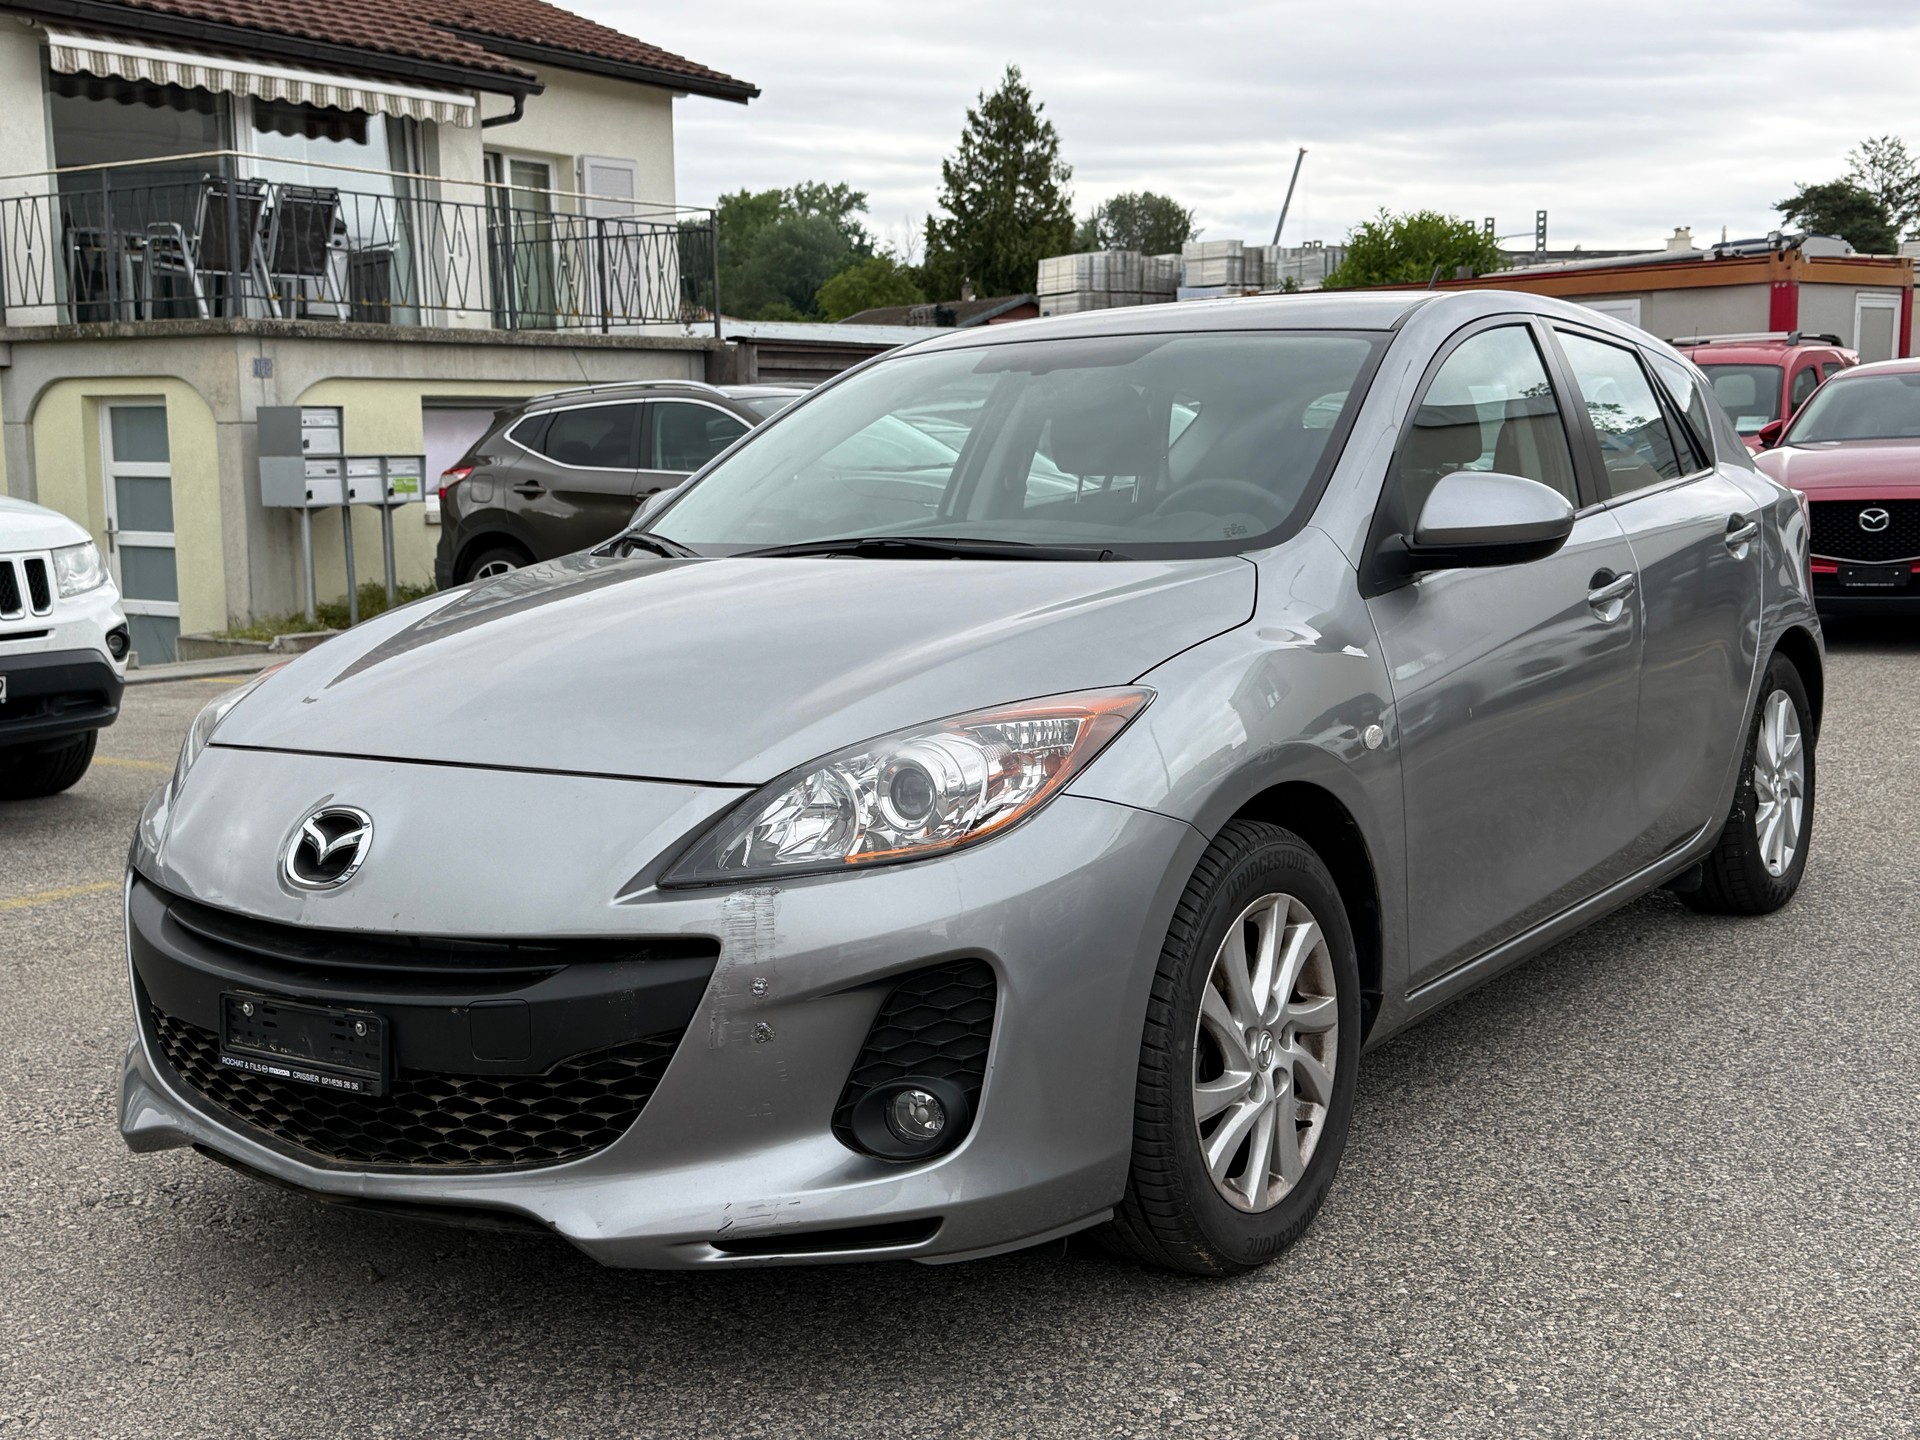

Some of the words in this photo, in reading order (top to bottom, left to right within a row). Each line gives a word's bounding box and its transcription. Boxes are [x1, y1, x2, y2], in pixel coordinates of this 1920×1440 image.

[222, 1056, 244, 1068] ROCHAT
[244, 1061, 249, 1070] &
[249, 1062, 262, 1072] FILS
[268, 1067, 290, 1077] mazda
[292, 1071, 320, 1082] CRISSIER
